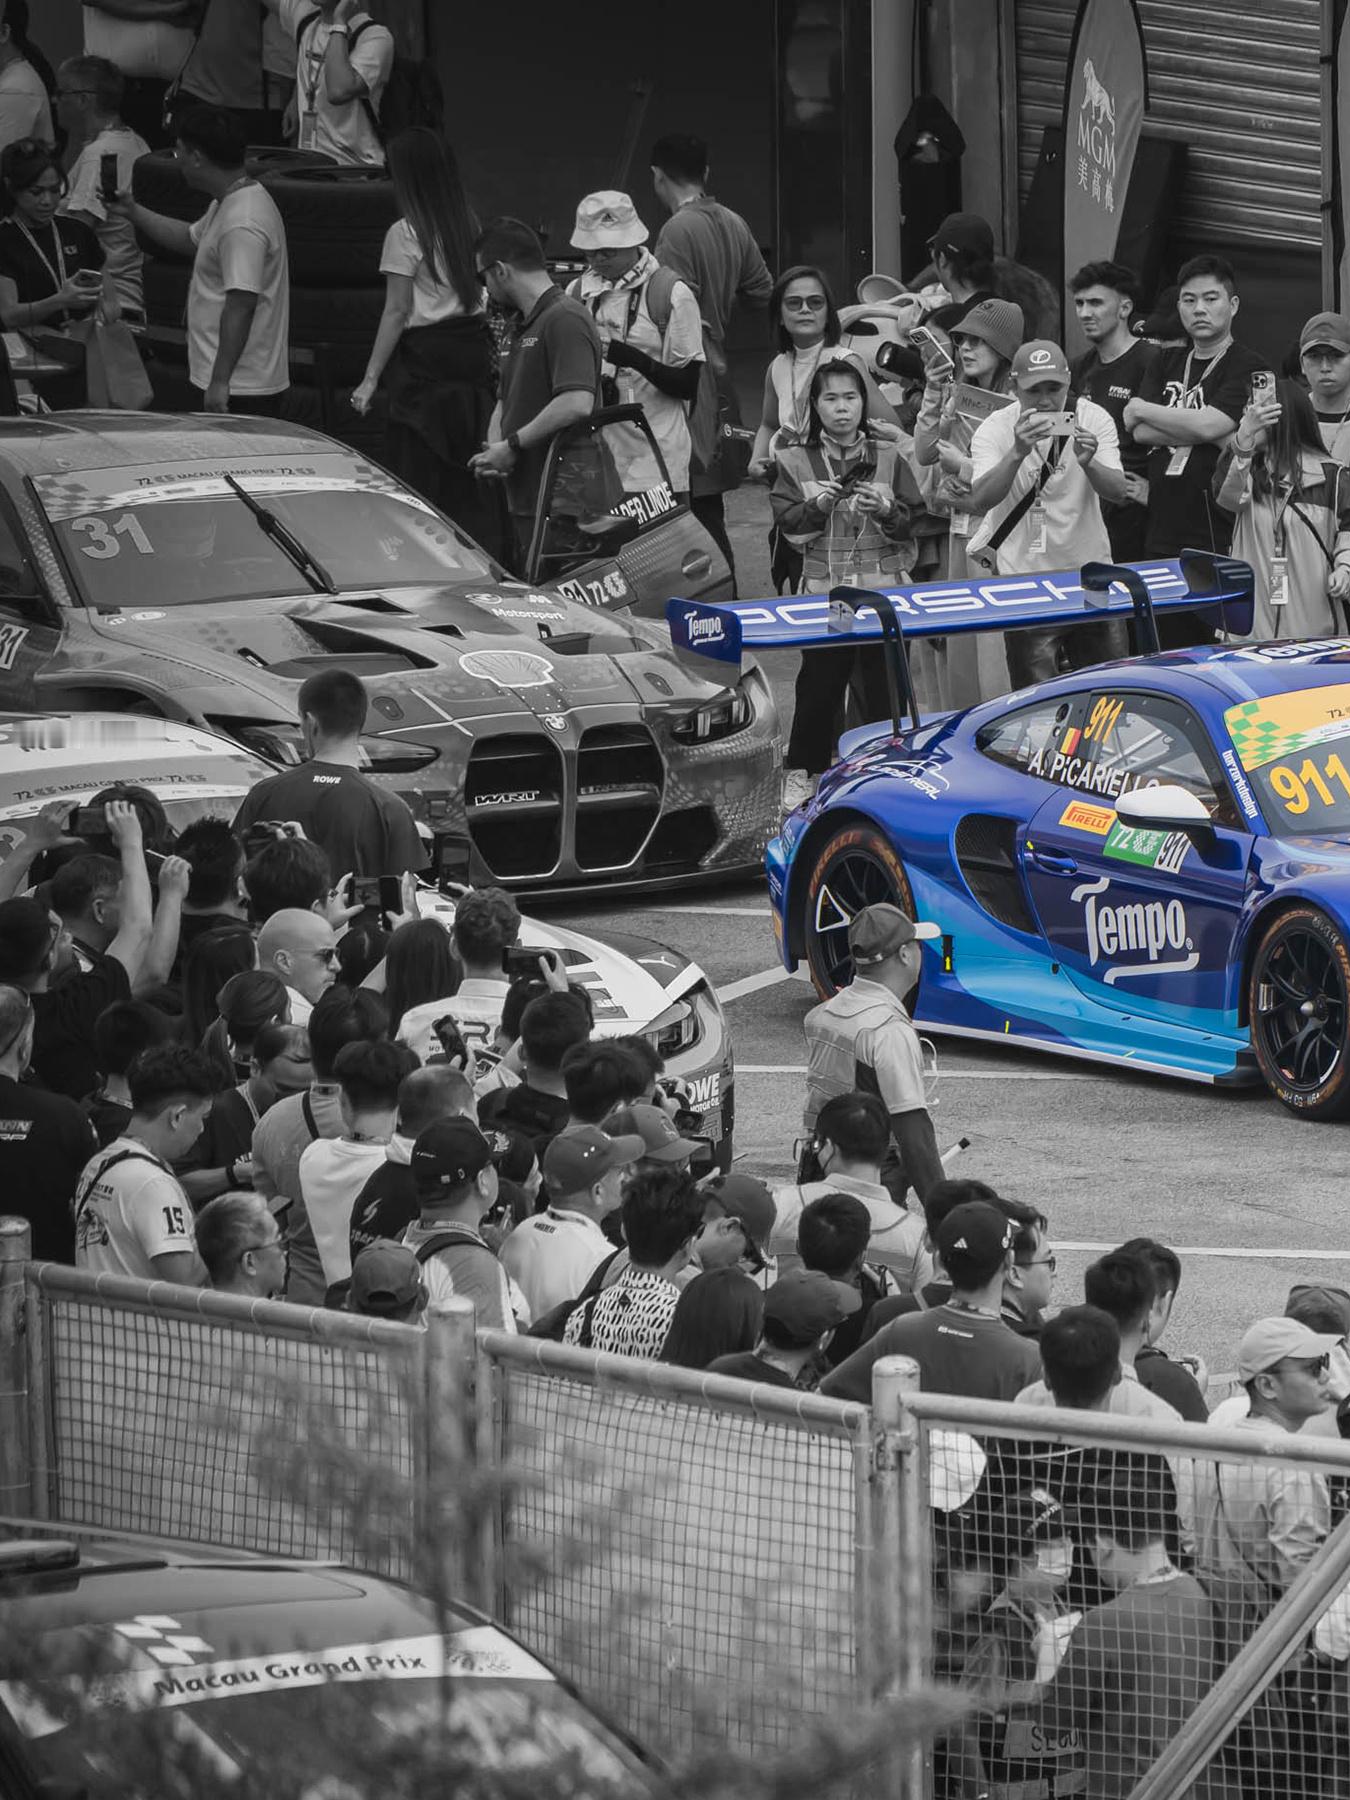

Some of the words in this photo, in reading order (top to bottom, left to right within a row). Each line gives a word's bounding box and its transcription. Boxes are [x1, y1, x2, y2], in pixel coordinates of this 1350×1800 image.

[1077, 110, 1116, 177] MGM
[643, 481, 678, 520] LINDE
[71, 513, 155, 560] 31
[586, 582, 609, 605] 72
[491, 608, 566, 620] Motorsport
[684, 610, 724, 643] Tempo
[1083, 696, 1124, 743] 911
[1326, 708, 1345, 719] 72
[1028, 749, 1045, 777] A.
[13, 791, 34, 800] 72
[58, 781, 97, 793] MACAU
[167, 774, 188, 783] 72
[312, 775, 342, 784] ROWE
[475, 789, 540, 807] WRT
[1067, 806, 1112, 829] PIRELLI
[1111, 826, 1135, 849] 72
[1158, 832, 1189, 869] 911
[1070, 877, 1187, 968] Tempo
[162, 1206, 187, 1235] 15
[152, 1668, 260, 1698] Macau
[264, 1655, 362, 1684] Grand
[366, 1653, 428, 1674] Prix
